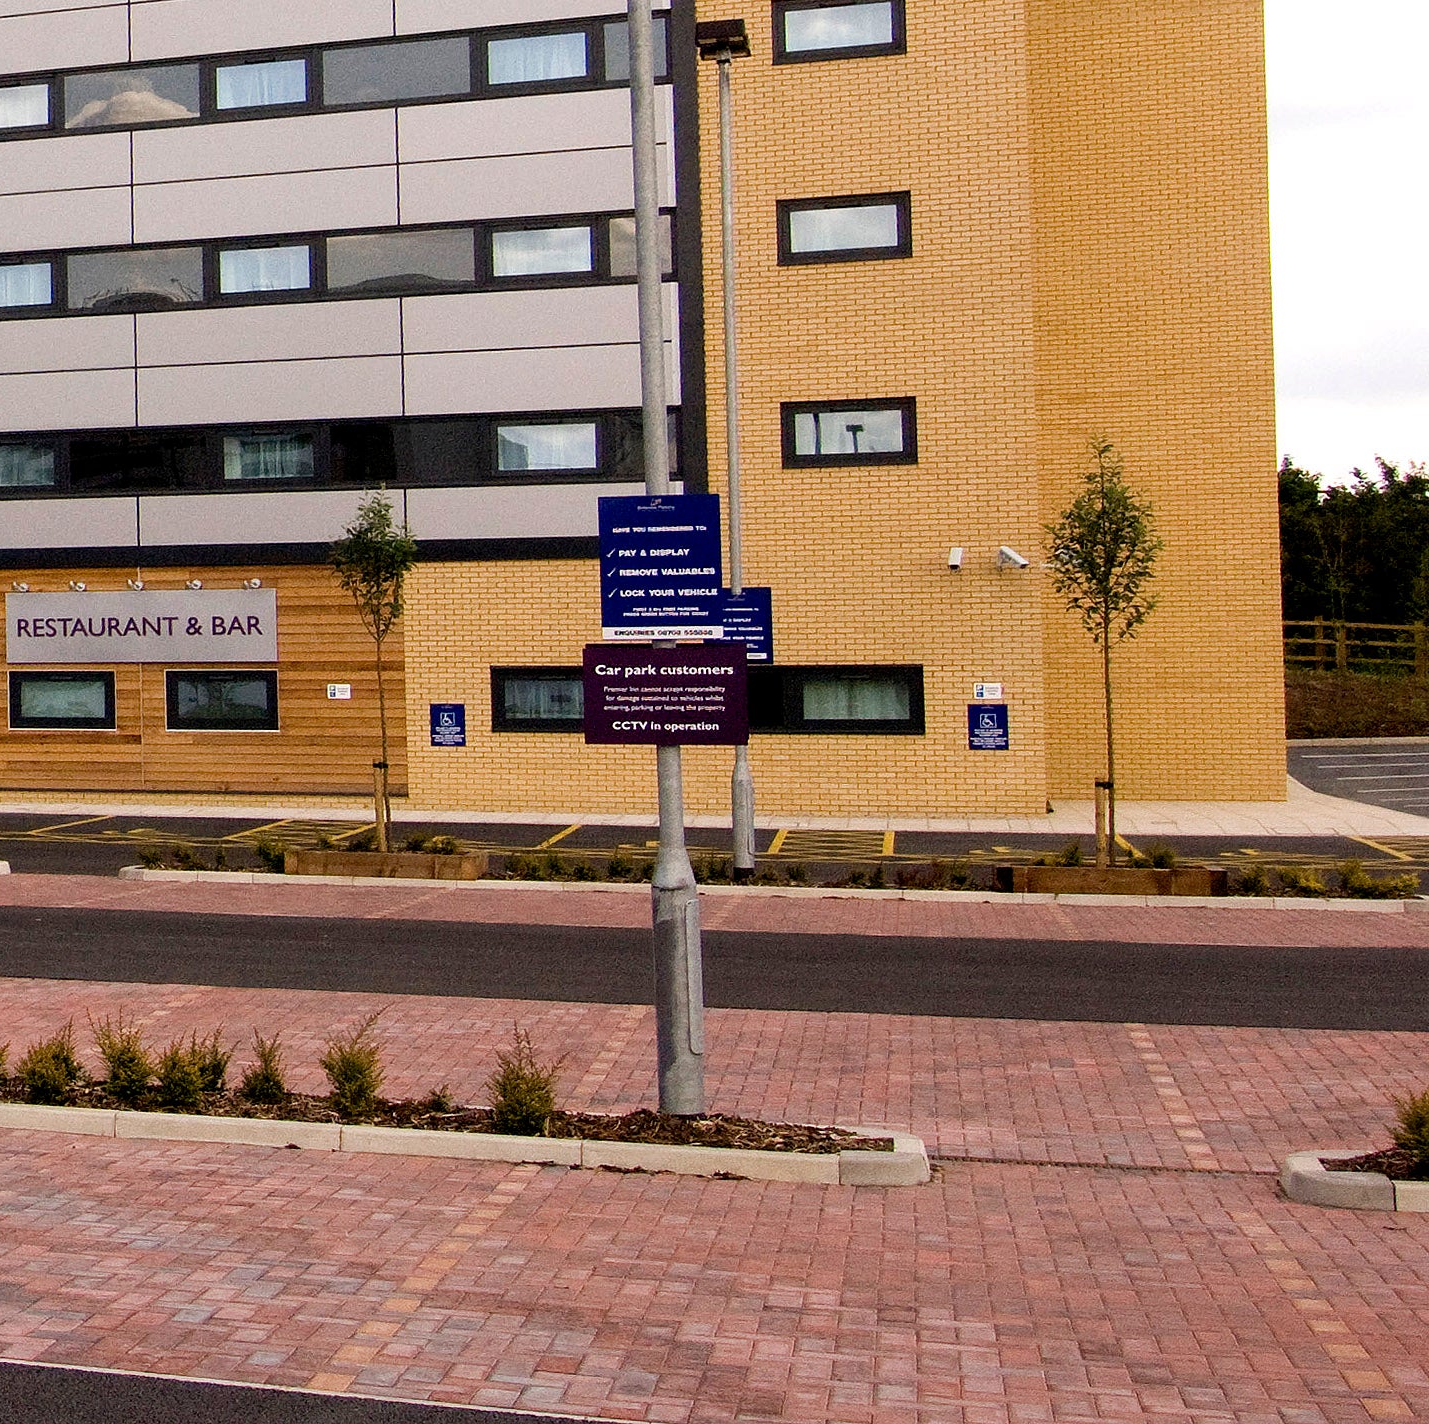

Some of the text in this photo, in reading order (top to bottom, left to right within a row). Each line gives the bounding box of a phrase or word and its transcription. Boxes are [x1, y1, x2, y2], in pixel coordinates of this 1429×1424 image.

[618, 549, 637, 557] PAY
[649, 548, 690, 556] DISPLAY
[619, 567, 716, 576] REMOVE VALUABLES
[619, 588, 718, 597] LOCK YOUR VEHICLE
[17, 615, 263, 638] RESTAURANT & BAR
[595, 664, 734, 678] Car park customers
[684, 685, 726, 693] responsibility
[679, 694, 704, 702] vehicles
[631, 704, 654, 712] parking
[664, 704, 685, 712] leaving
[698, 704, 726, 712] property
[612, 721, 720, 732] CCTV in operation
